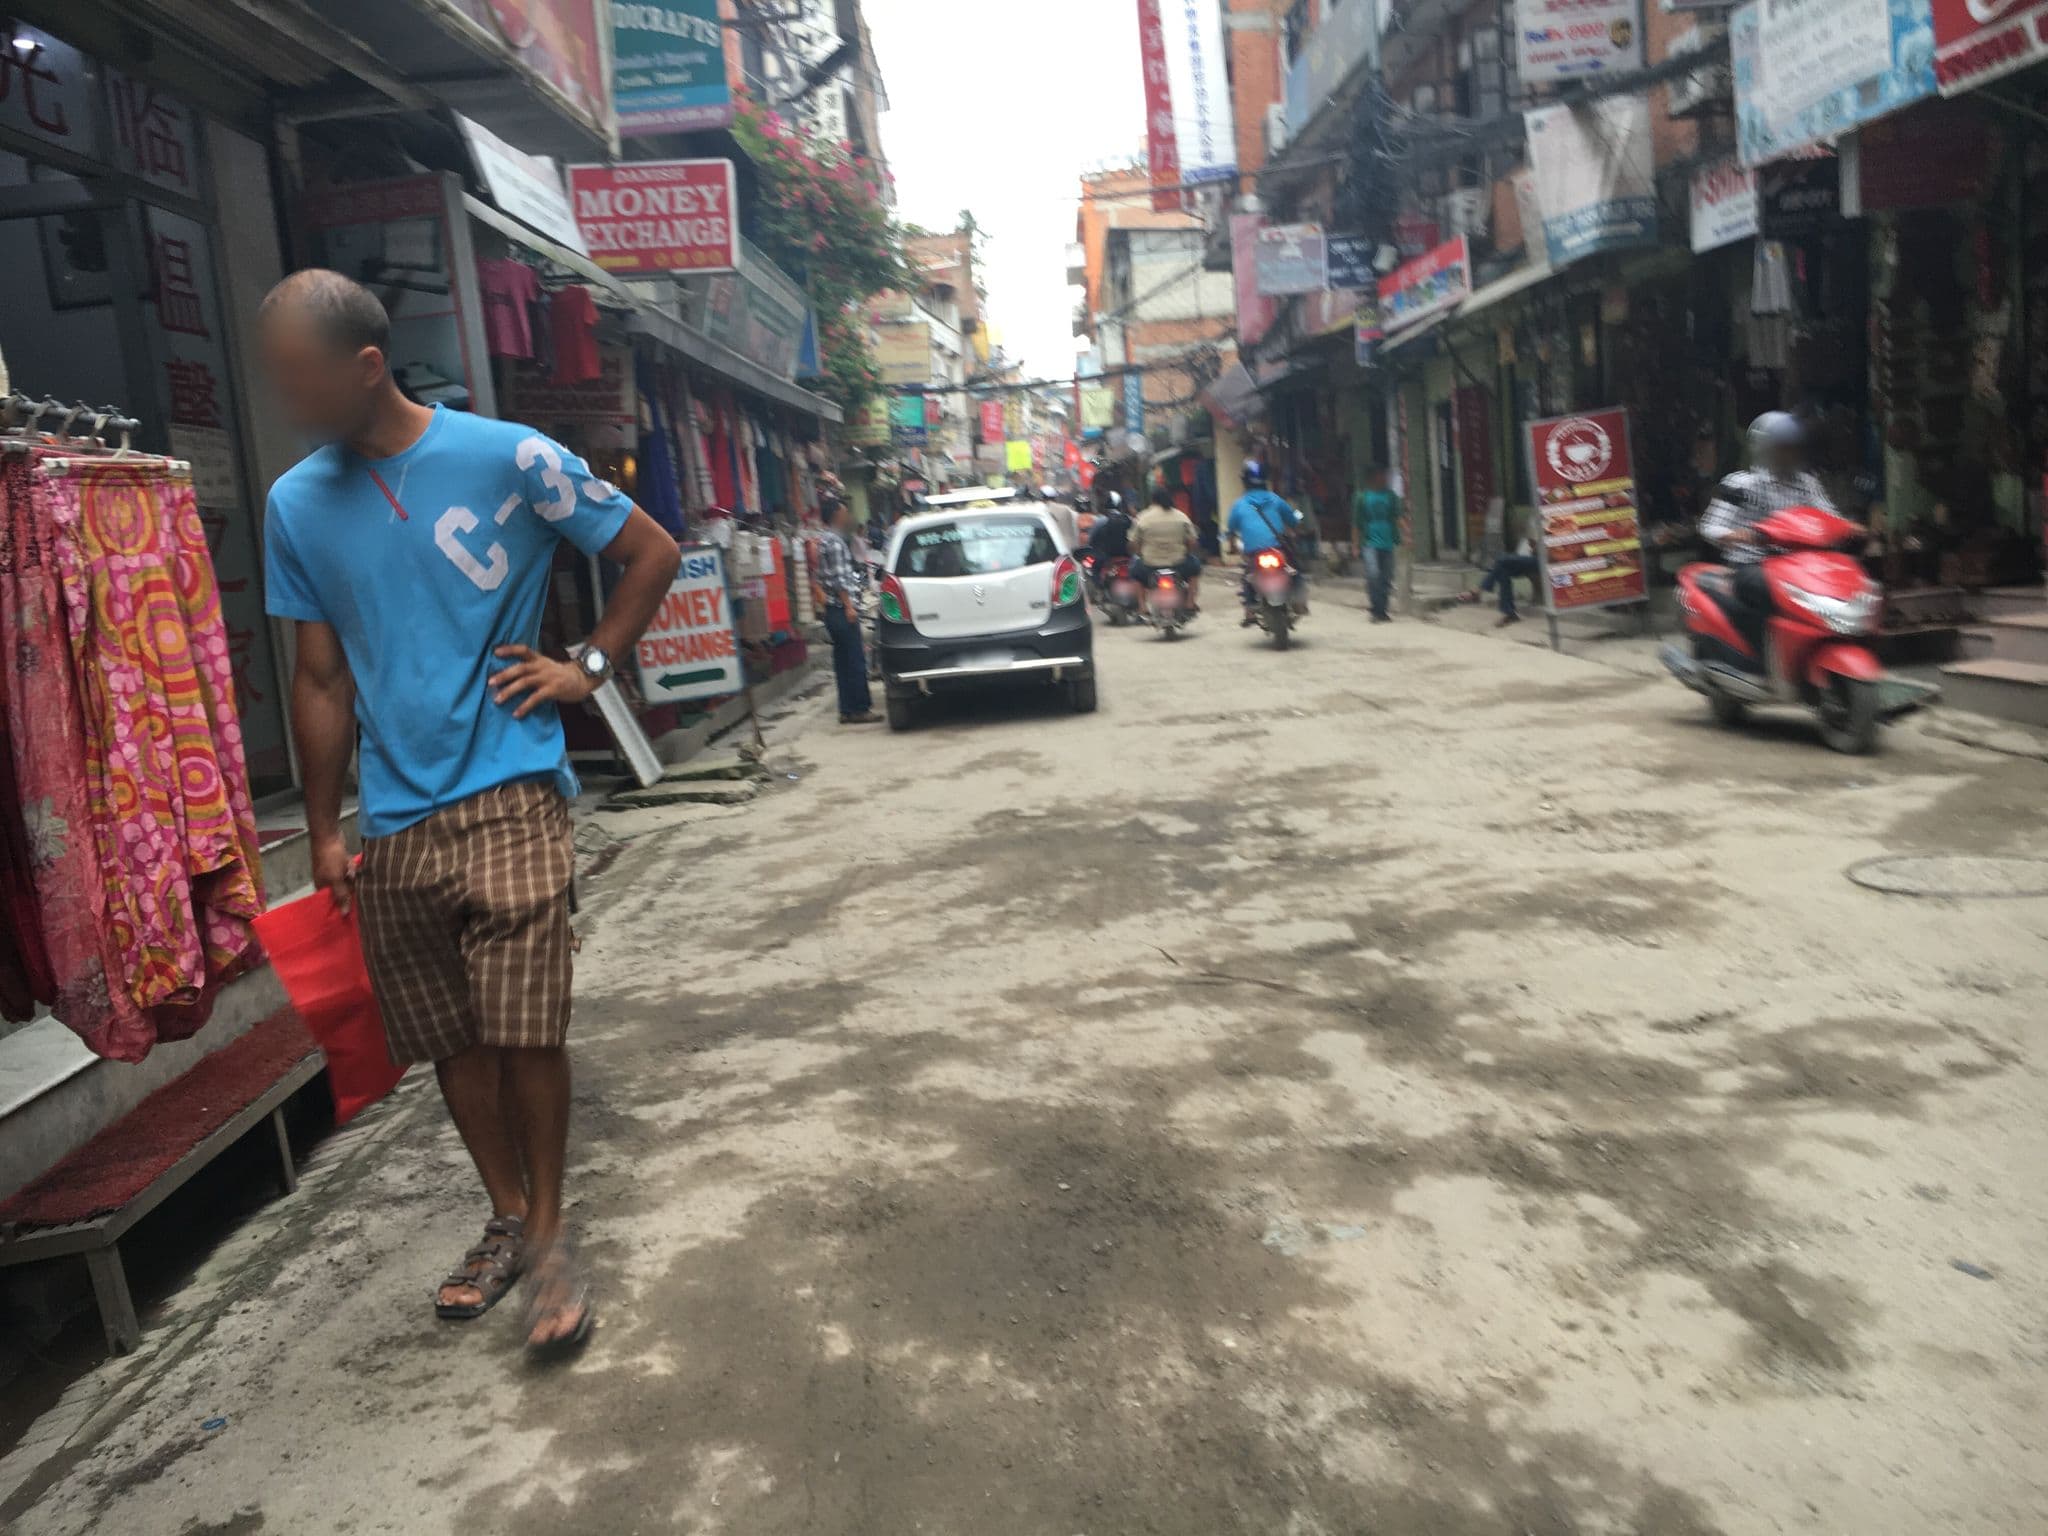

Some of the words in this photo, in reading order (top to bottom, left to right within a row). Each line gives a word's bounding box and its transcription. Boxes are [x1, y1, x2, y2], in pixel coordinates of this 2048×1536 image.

[577, 185, 725, 218] MONEY
[581, 217, 727, 251] EXCHANGE
[648, 587, 723, 632] ONEY
[638, 630, 736, 669] EXCHANGE
